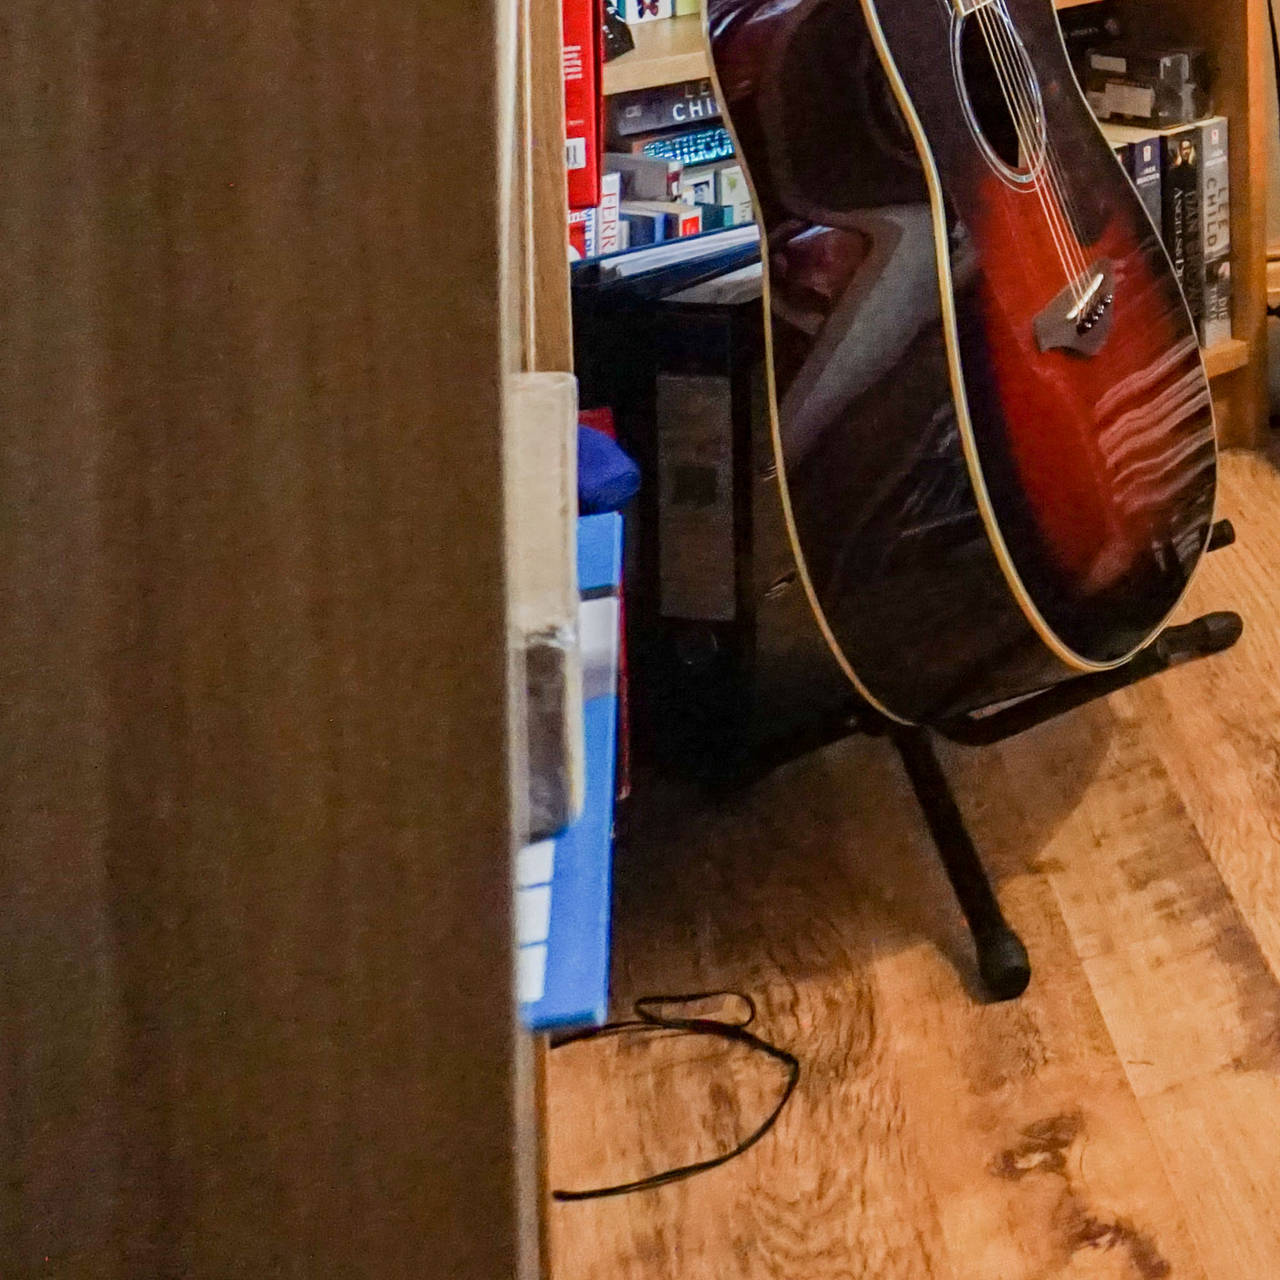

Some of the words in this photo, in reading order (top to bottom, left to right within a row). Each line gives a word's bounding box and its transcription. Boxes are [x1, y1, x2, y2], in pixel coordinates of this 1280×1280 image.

[672, 98, 721, 121] CHI
[602, 192, 617, 251] FERR
[1206, 177, 1217, 248] CHILD
[1217, 187, 1227, 228] LEE
[1217, 296, 1227, 321] DIE
